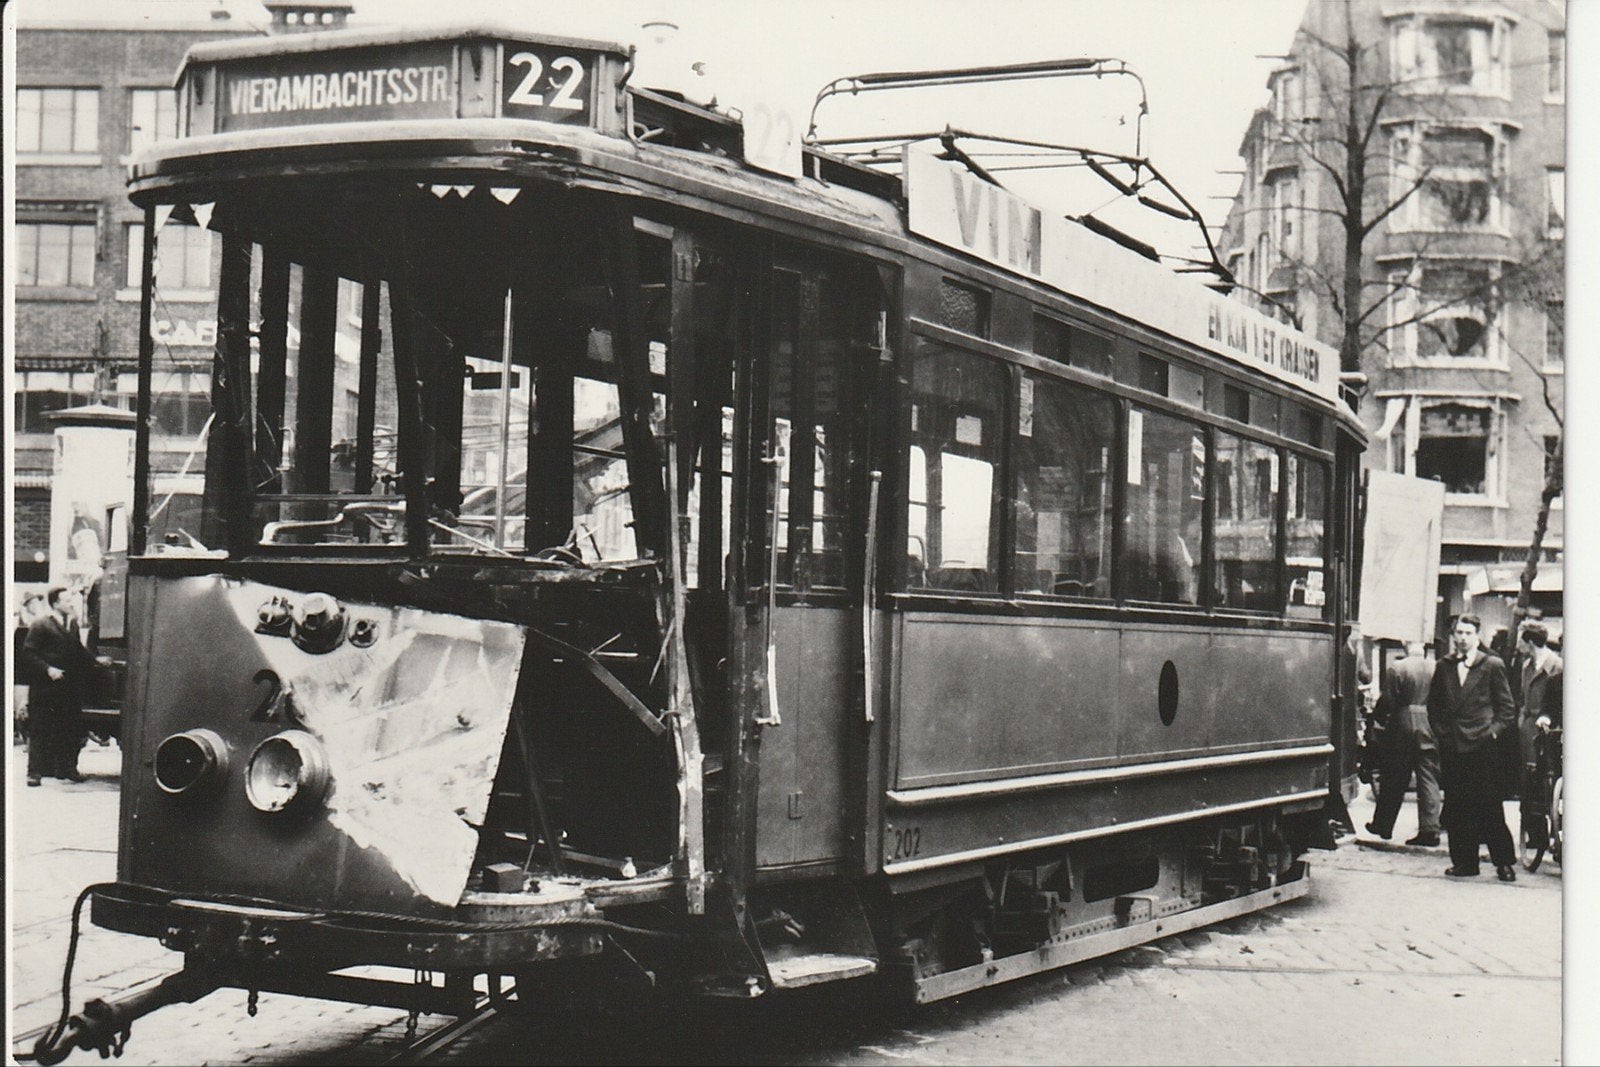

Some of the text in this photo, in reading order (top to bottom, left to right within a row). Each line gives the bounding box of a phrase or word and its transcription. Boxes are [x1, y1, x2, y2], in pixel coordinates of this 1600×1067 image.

[508, 52, 584, 110] 22
[752, 102, 795, 172] 22
[950, 168, 1042, 276] VIM
[151, 320, 218, 346] CAF
[894, 827, 920, 860] 202
